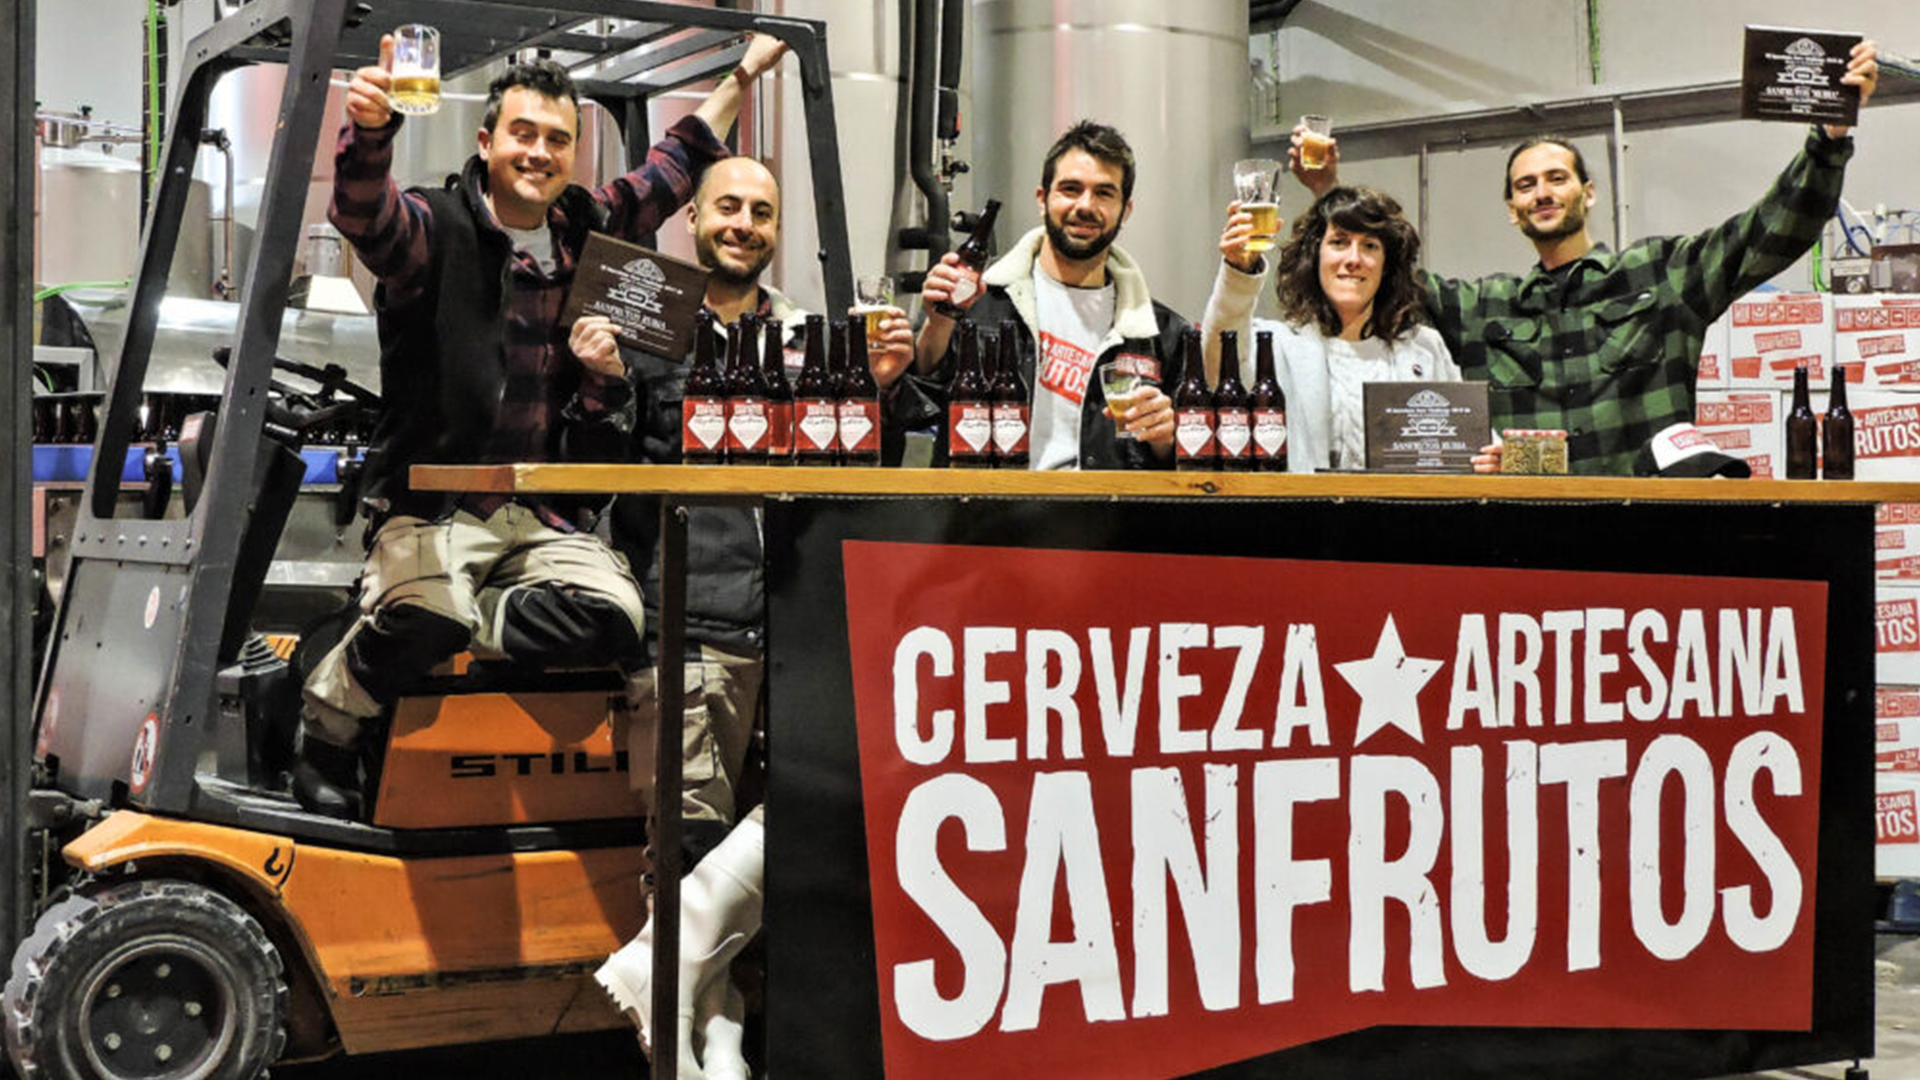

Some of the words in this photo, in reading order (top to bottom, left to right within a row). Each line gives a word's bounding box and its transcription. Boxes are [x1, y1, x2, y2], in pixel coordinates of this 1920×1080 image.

[1865, 407, 1918, 427] ARTESANA
[893, 622, 1331, 765] CERVEZA
[1446, 606, 1806, 730] ARTESANA
[894, 730, 1803, 1041] SANFRUTOS
